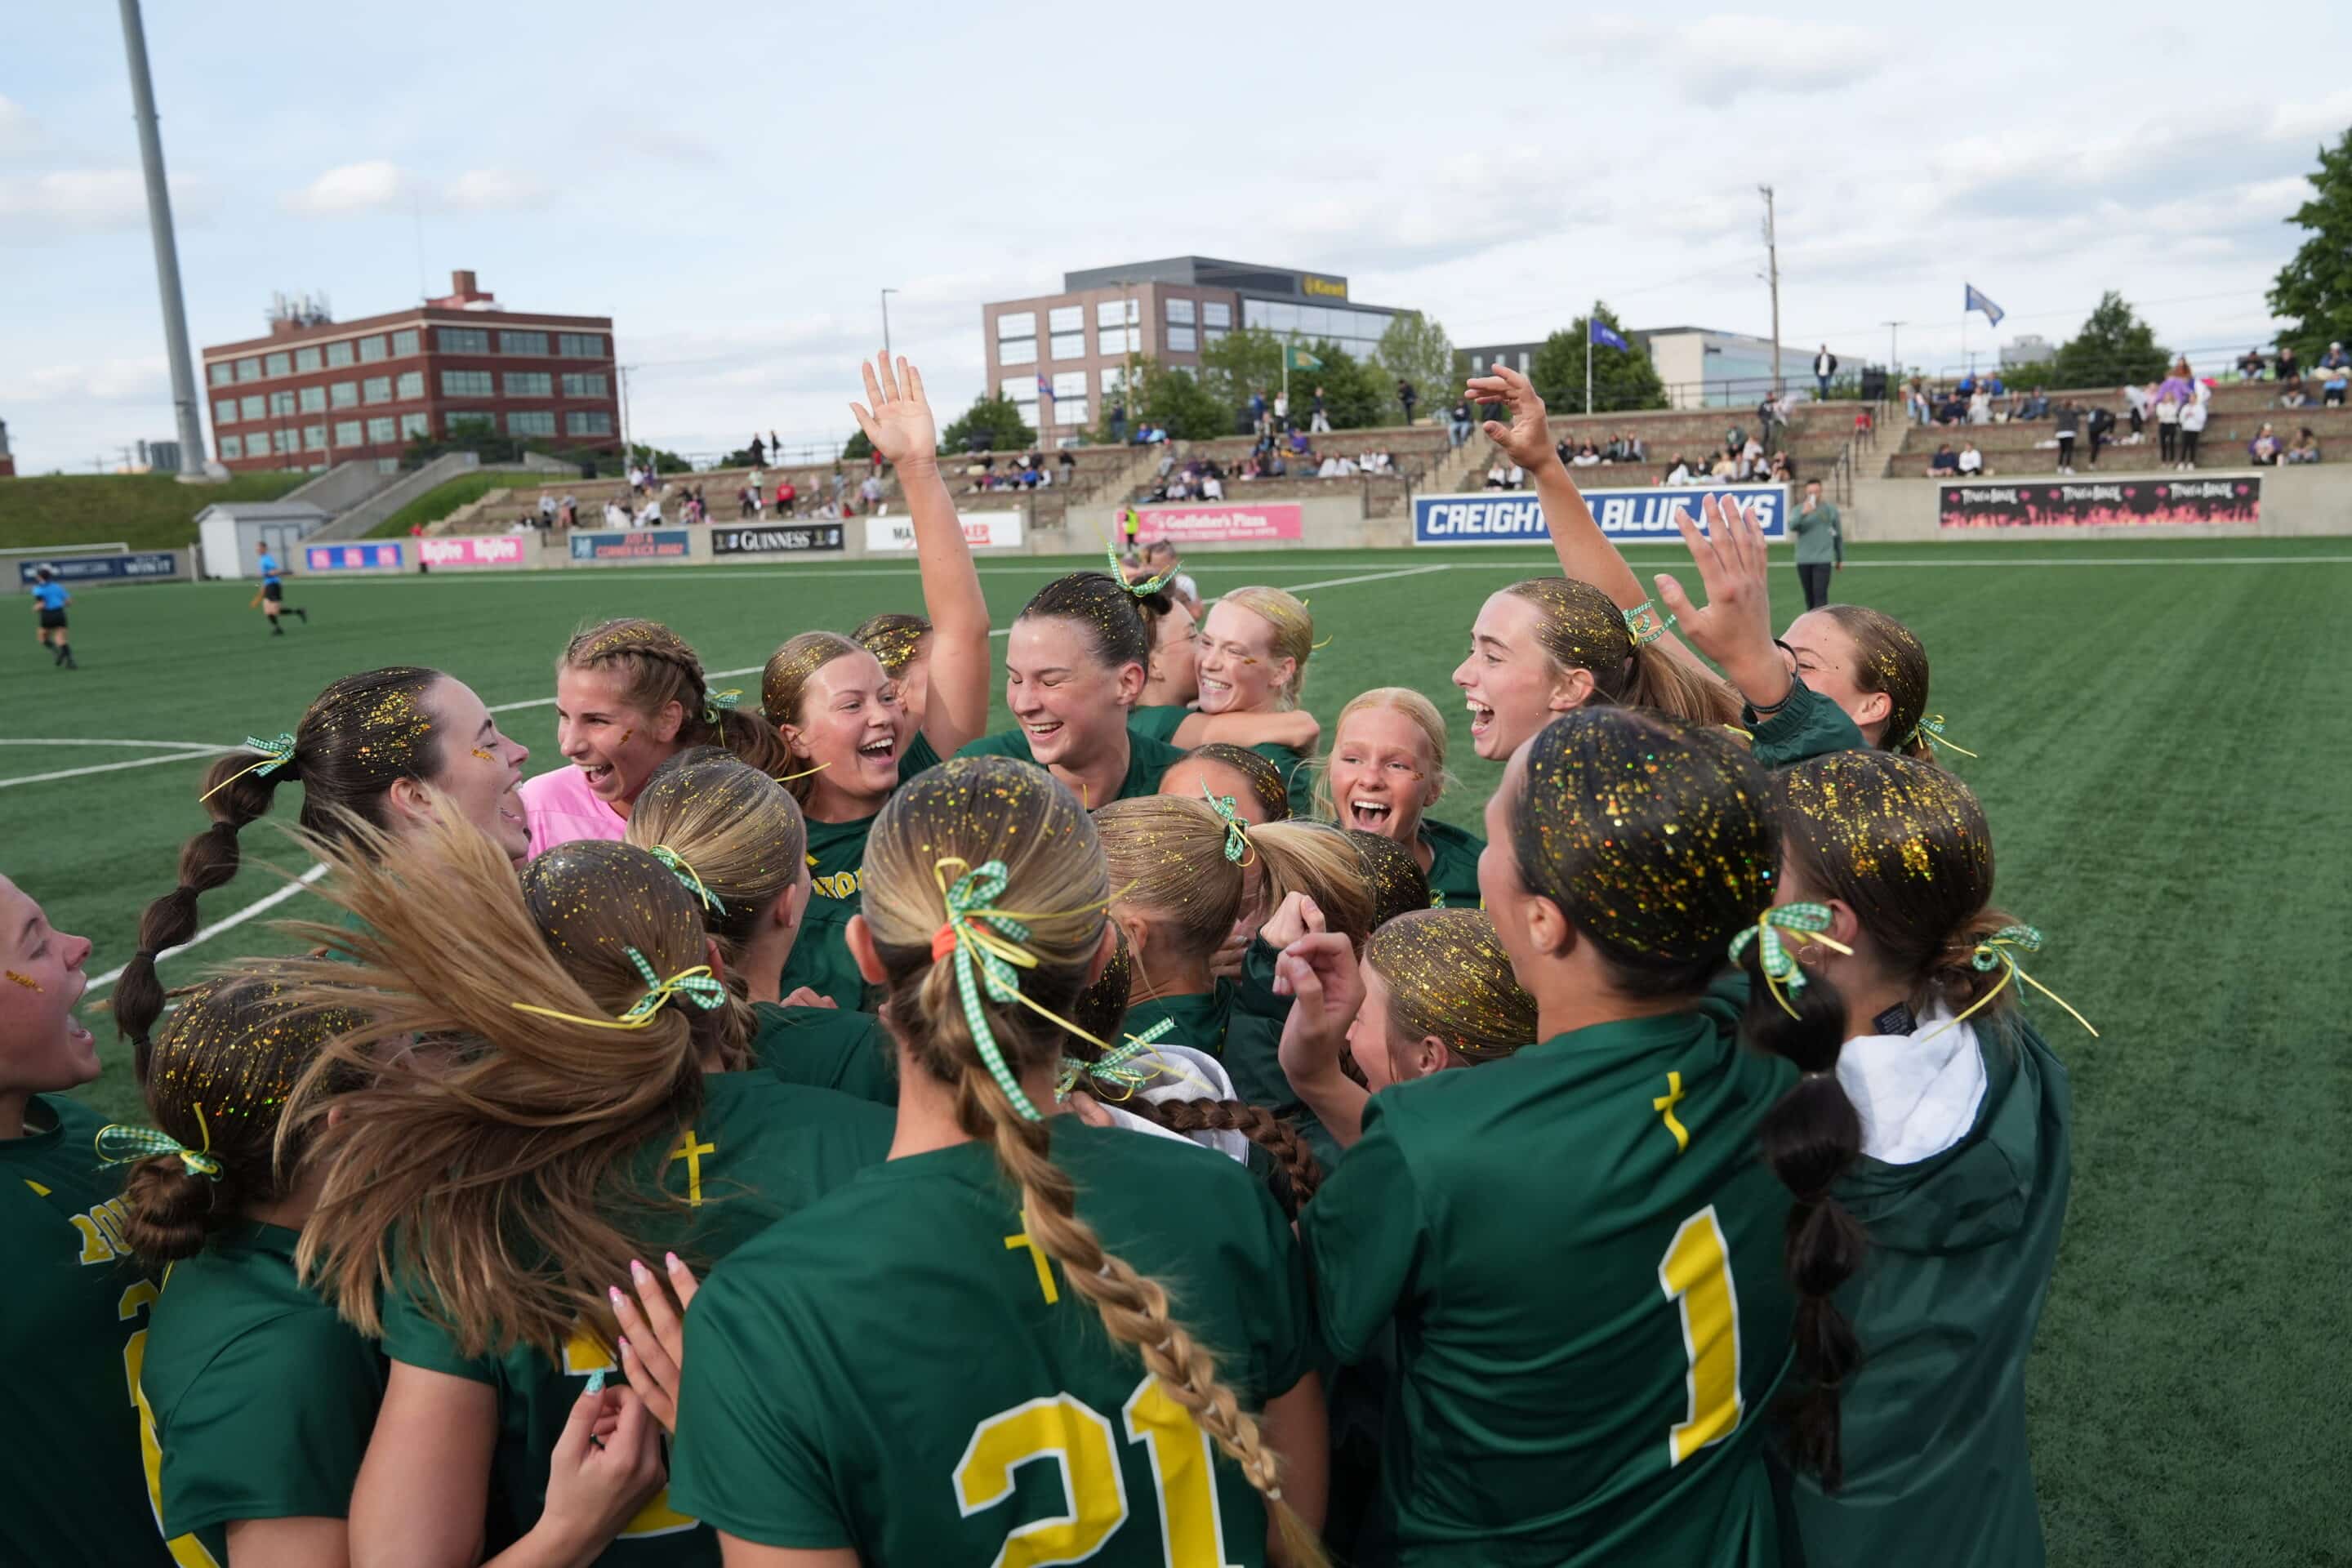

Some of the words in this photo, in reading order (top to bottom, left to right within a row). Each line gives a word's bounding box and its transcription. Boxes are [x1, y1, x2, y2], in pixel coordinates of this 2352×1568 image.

[741, 531, 812, 550] GUINNESS
[1427, 501, 1595, 535] CREIGHT
[1658, 1204, 1745, 1468] 1
[952, 1373, 1244, 1568] 21
